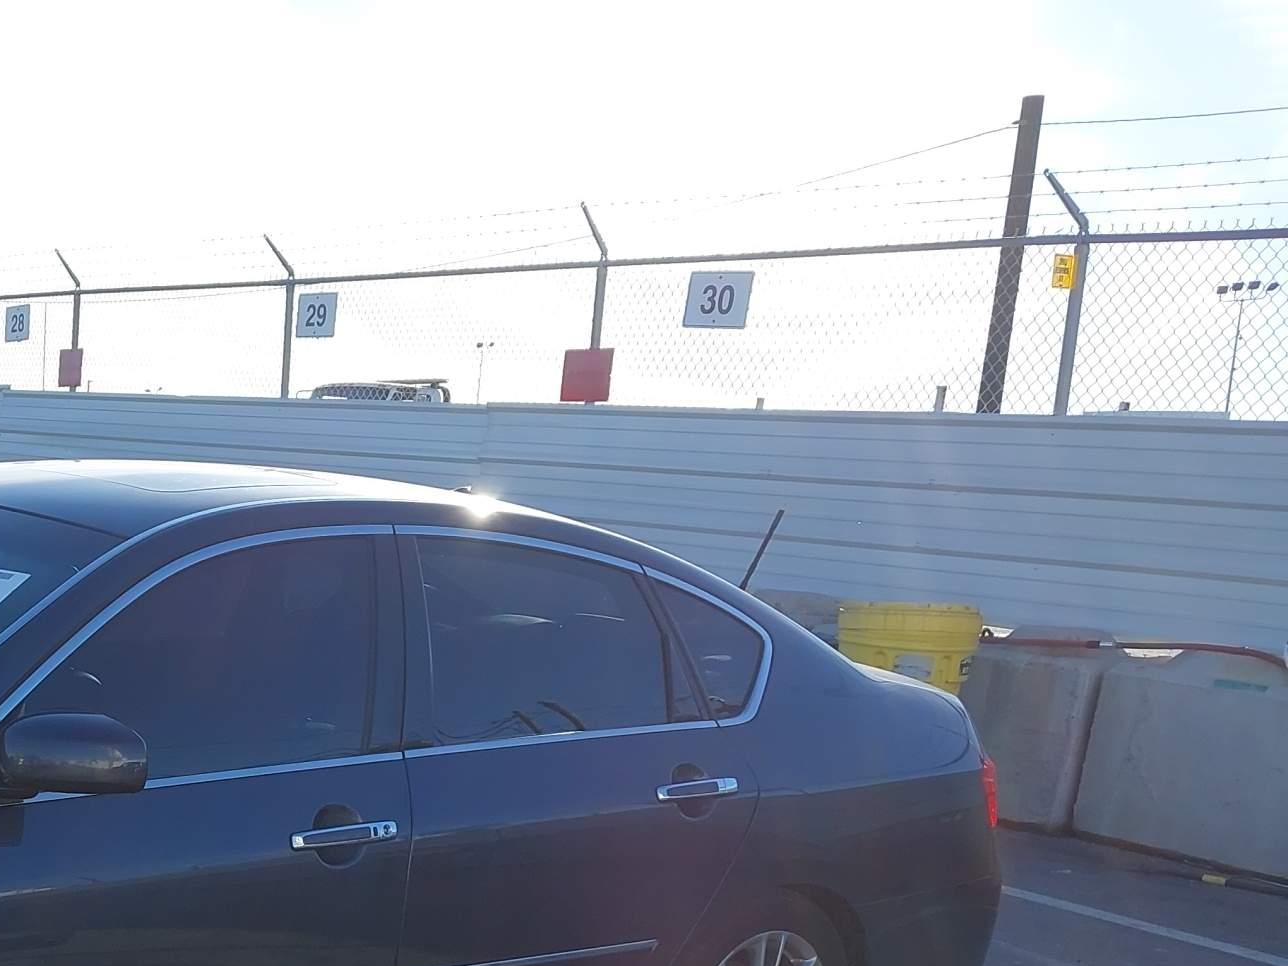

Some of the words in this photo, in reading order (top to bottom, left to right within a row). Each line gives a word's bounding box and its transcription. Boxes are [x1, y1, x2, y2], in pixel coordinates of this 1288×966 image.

[700, 284, 735, 315] 30
[10, 313, 25, 333] 28
[305, 303, 327, 327] 29
